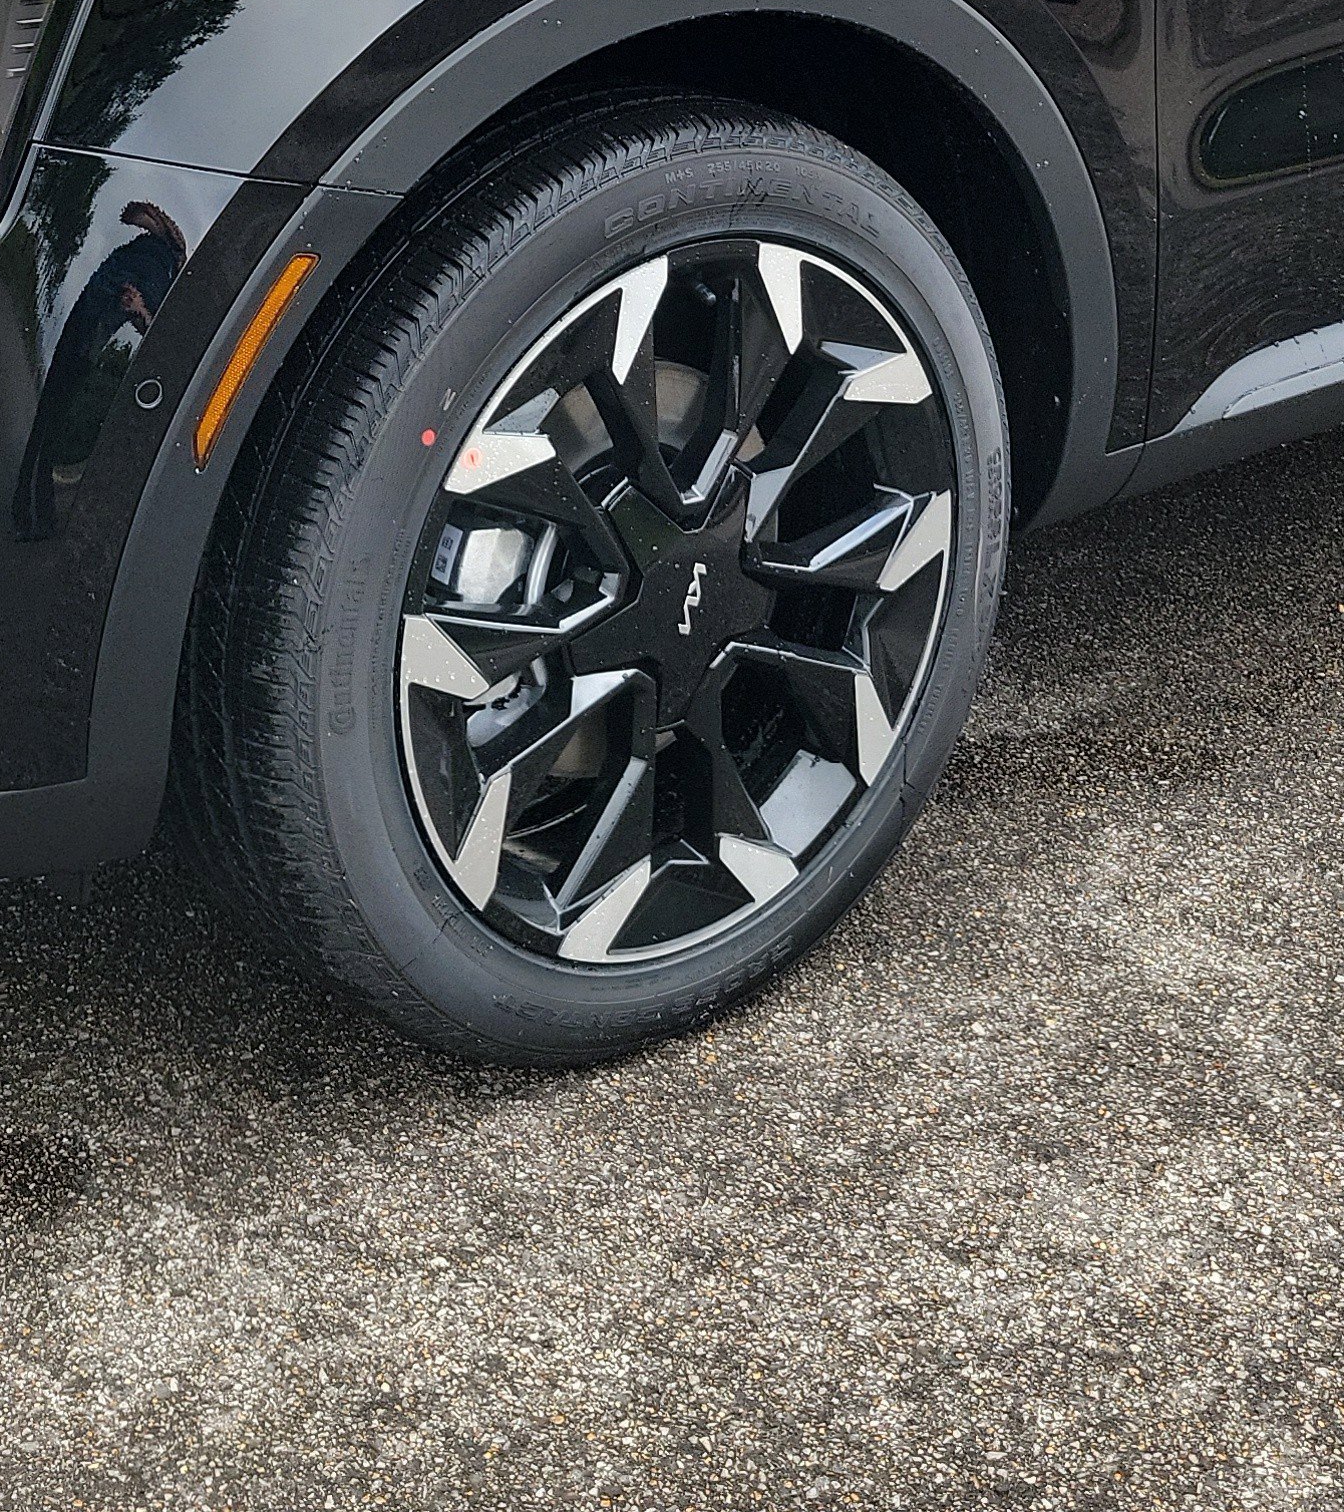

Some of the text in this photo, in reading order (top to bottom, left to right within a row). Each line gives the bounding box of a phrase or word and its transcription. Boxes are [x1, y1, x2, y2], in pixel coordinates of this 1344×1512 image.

[604, 175, 881, 238] CONTINENTAL
[664, 167, 694, 185] M+S
[677, 561, 709, 637] KIA
